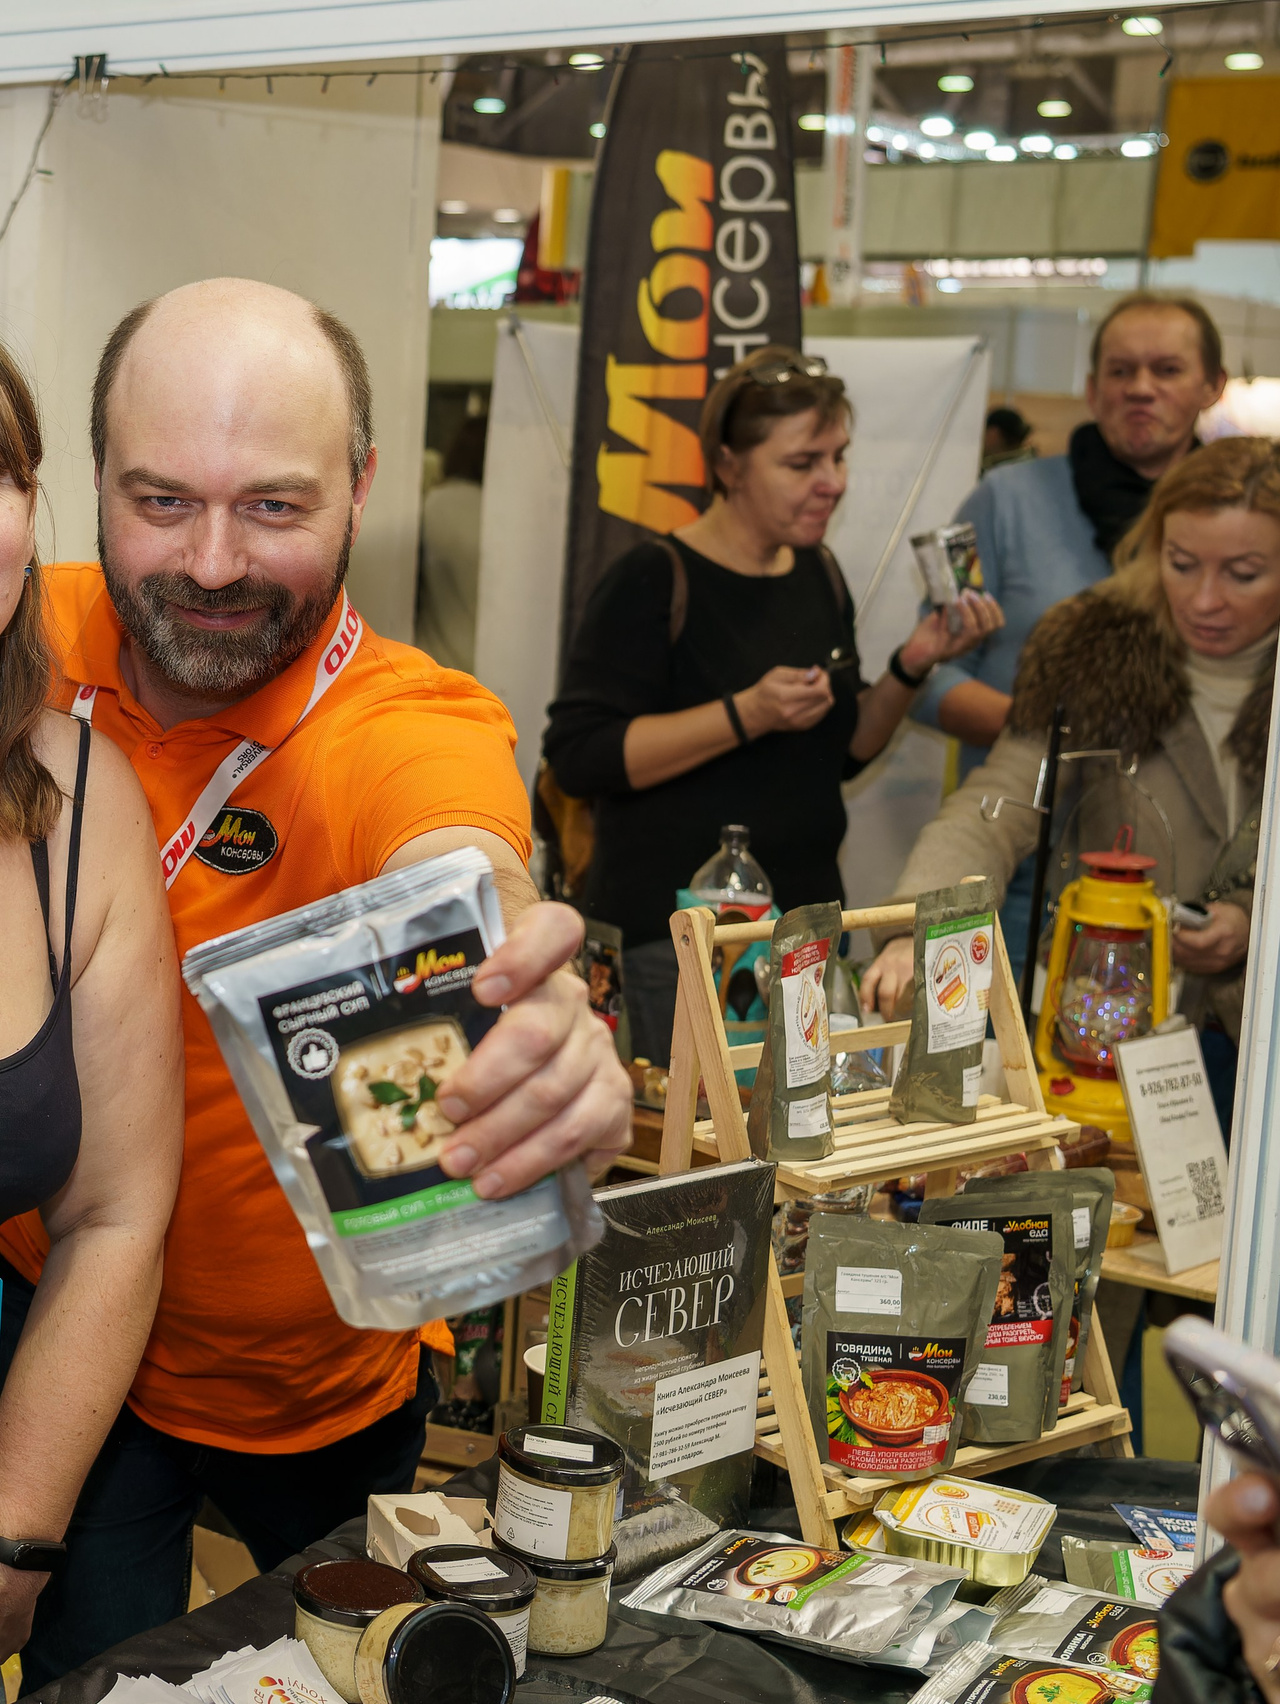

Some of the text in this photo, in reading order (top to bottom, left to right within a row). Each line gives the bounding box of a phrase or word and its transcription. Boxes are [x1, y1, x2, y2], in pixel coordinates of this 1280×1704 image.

[221, 846, 264, 862] консервы
[339, 995, 370, 1017] СУП
[646, 1213, 718, 1236] Александр Моисеев
[1008, 1219, 1049, 1232] Удобная
[1029, 1229, 1049, 1238] еда
[618, 1243, 735, 1293] ИСЧЕЗАЮЩИЙ
[879, 1298, 901, 1306] 360,00
[614, 1274, 735, 1348] СЕВЕР
[547, 1276, 569, 1396] ИСЧЕЗАЮЩИЙ
[835, 1342, 893, 1356] ГОВЯДИНА
[923, 1342, 953, 1359] Мои
[860, 1355, 893, 1364] ТУШЕНАЯ
[926, 1357, 961, 1366] консервы
[656, 1366, 750, 1402] Книга Александра Моисеева
[655, 1388, 728, 1416] «Исчезающий СЕВЕР»
[654, 1429, 668, 1438] Книгу
[668, 1424, 685, 1434] можно
[684, 1416, 710, 1429] приобрести
[732, 1405, 747, 1414] автору
[653, 1439, 665, 1448] 2500
[664, 1434, 681, 1446] рублей
[688, 1427, 705, 1437] номеру
[705, 1420, 727, 1431] телефона
[690, 1435, 715, 1448] Александр
[651, 1457, 677, 1470] Открытка
[680, 1449, 704, 1461] подарок.
[847, 1453, 899, 1464] РЕКОМЕНДУЕМ
[852, 1448, 933, 1458] ПЕРЕД УПОТРЕБЛЕНИЕМ
[840, 1457, 850, 1465] НО
[856, 1462, 898, 1470] ХОЛОДНЫМ
[899, 1462, 916, 1470] ТОЖЕ
[1086, 1604, 1115, 1629] Удобная
[1108, 1605, 1124, 1617] еда
[1060, 1632, 1087, 1660] ОЛЯНКА
